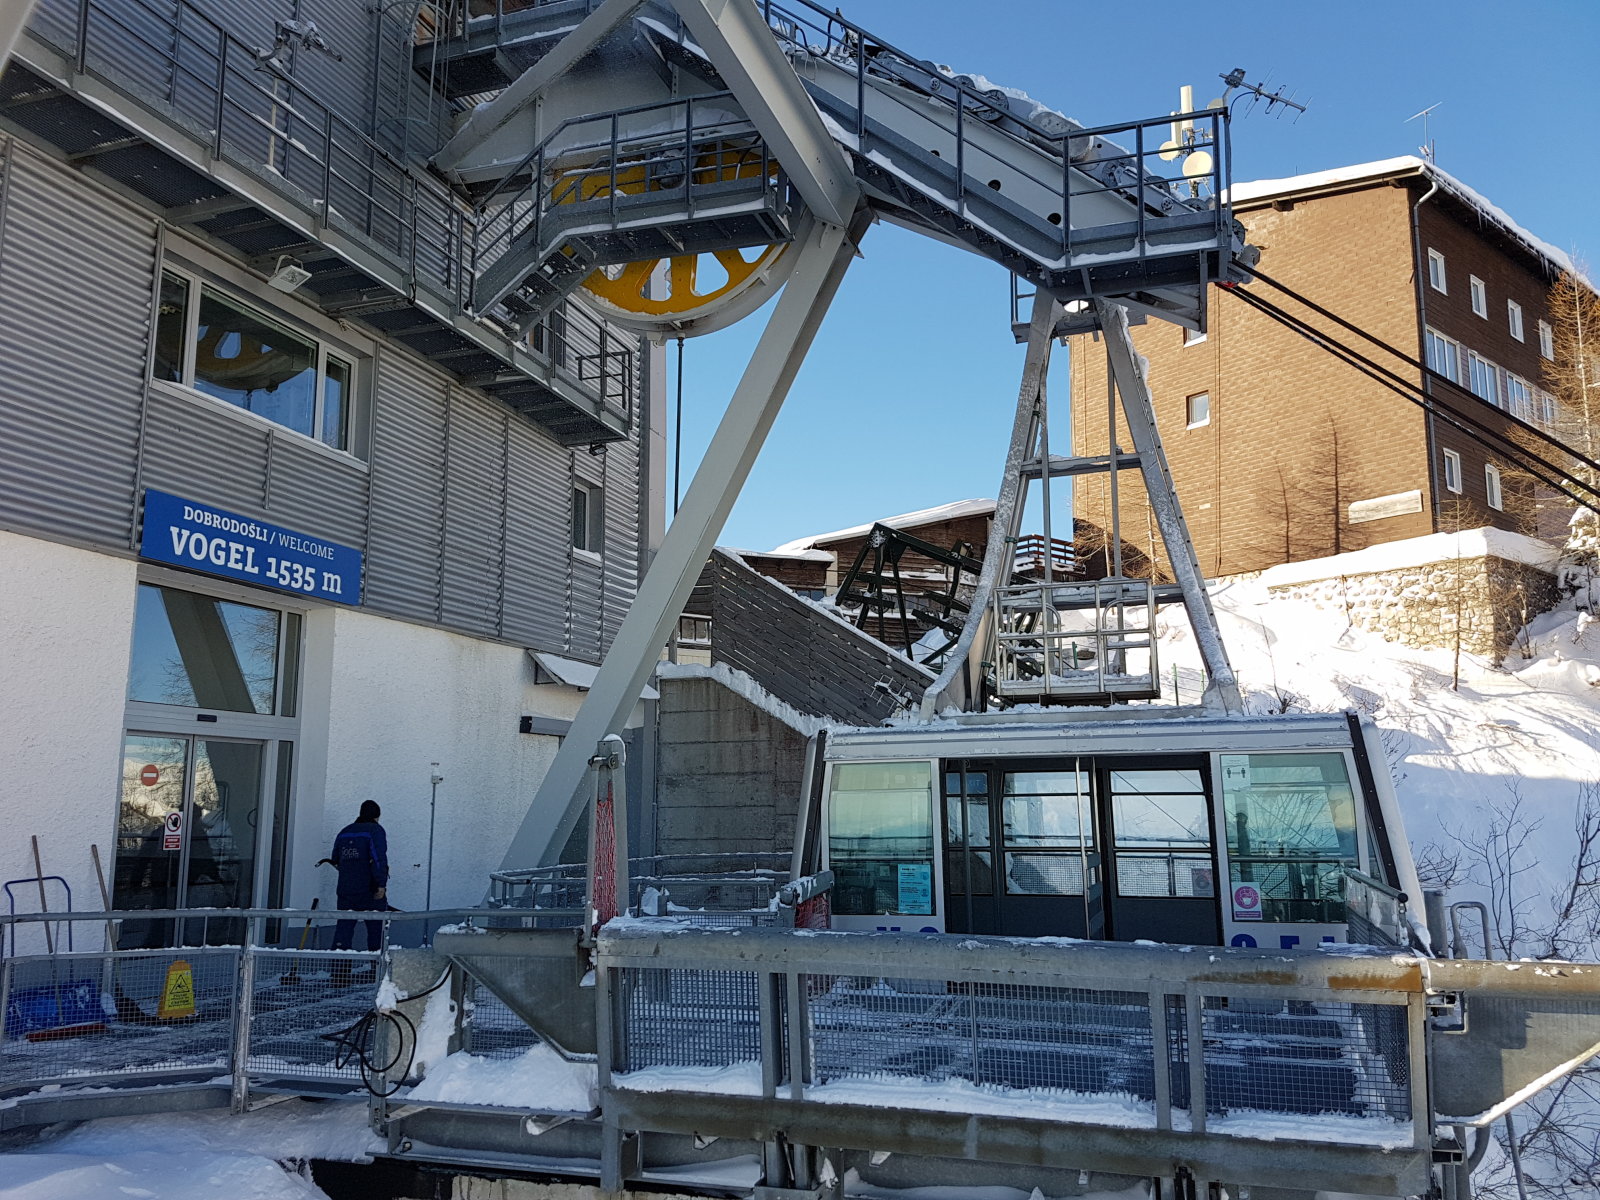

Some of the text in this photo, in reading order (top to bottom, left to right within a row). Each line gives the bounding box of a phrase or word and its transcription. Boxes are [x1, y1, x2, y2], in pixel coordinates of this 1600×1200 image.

[170, 526, 342, 594] VOGEL 1535 m
[184, 505, 267, 541] DOBRODOŠLI
[278, 532, 335, 560] WELCOME
